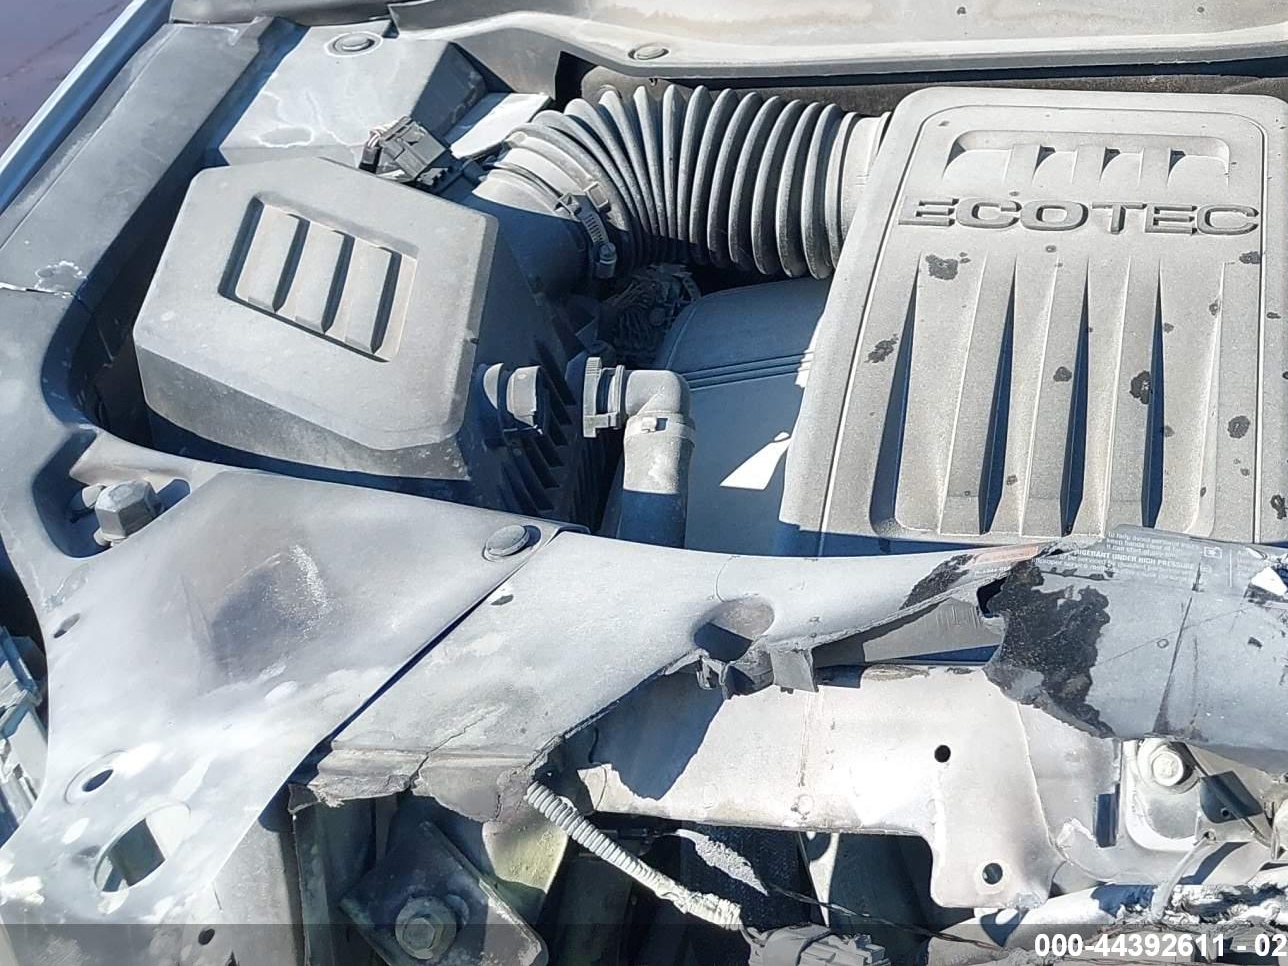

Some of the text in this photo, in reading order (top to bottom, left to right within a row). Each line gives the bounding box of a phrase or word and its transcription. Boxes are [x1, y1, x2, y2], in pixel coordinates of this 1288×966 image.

[898, 196, 1260, 236] ECOTEC
[1111, 554, 1137, 563] UNDER
[1137, 557, 1156, 565] HIGH
